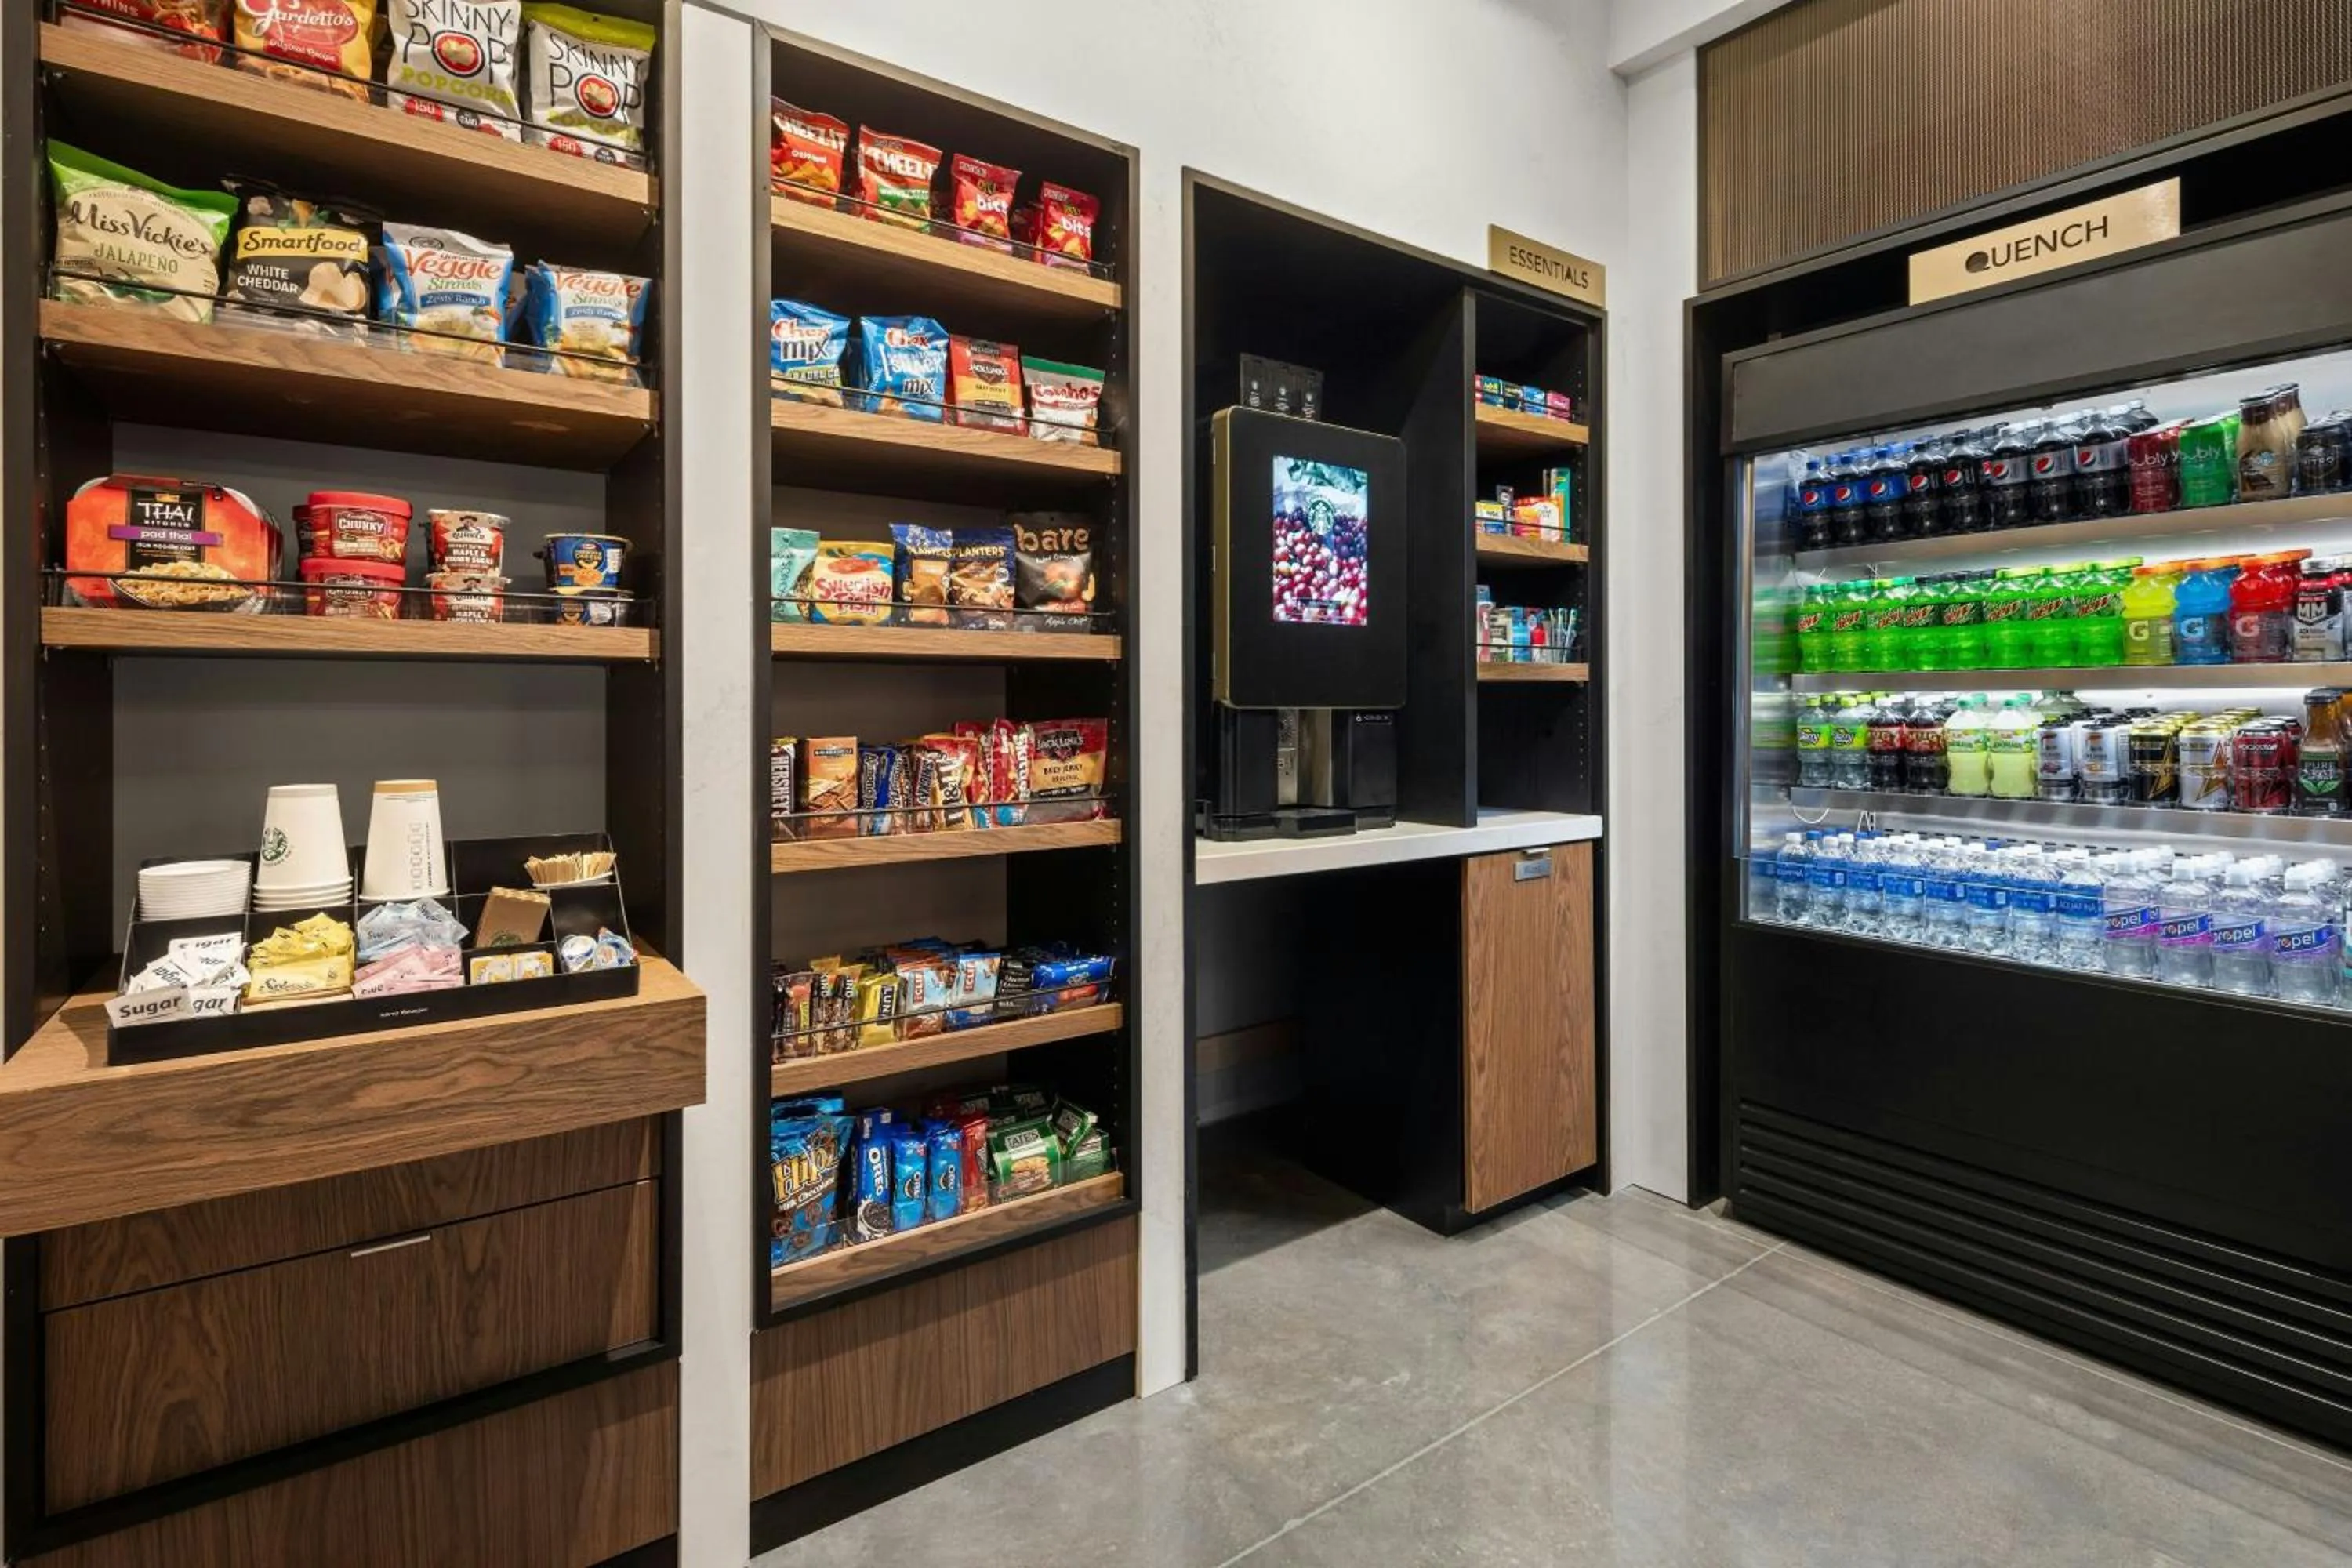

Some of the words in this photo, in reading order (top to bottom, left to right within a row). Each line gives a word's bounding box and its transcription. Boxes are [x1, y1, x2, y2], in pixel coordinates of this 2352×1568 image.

[405, 0, 512, 36] SKINNY
[403, 22, 508, 85] POP
[549, 34, 642, 82] SKINNY
[550, 63, 641, 124] POP
[414, 100, 436, 114] 150
[66, 200, 129, 236] Miss
[125, 209, 212, 260] Vickie's
[243, 230, 362, 253] Smartfood
[1965, 215, 2109, 274] QUENCH
[247, 263, 289, 280] WHITE
[404, 249, 502, 281] Veggie
[1509, 245, 1589, 289] ESSENTIALS
[238, 275, 299, 295] CHEDDAR
[557, 271, 641, 298] Veggie
[782, 339, 829, 364] mix
[136, 502, 194, 522] THAI
[140, 531, 166, 541] pad
[338, 518, 384, 533] CHUNKY
[1014, 524, 1090, 552] bare
[815, 576, 891, 600] Swedish
[2129, 621, 2150, 641] G
[2181, 617, 2205, 638] G
[2236, 615, 2260, 637] G
[2106, 910, 2142, 930] ropel
[119, 996, 183, 1018] Sugar
[192, 996, 227, 1014] gar
[869, 1147, 885, 1197] OREO
